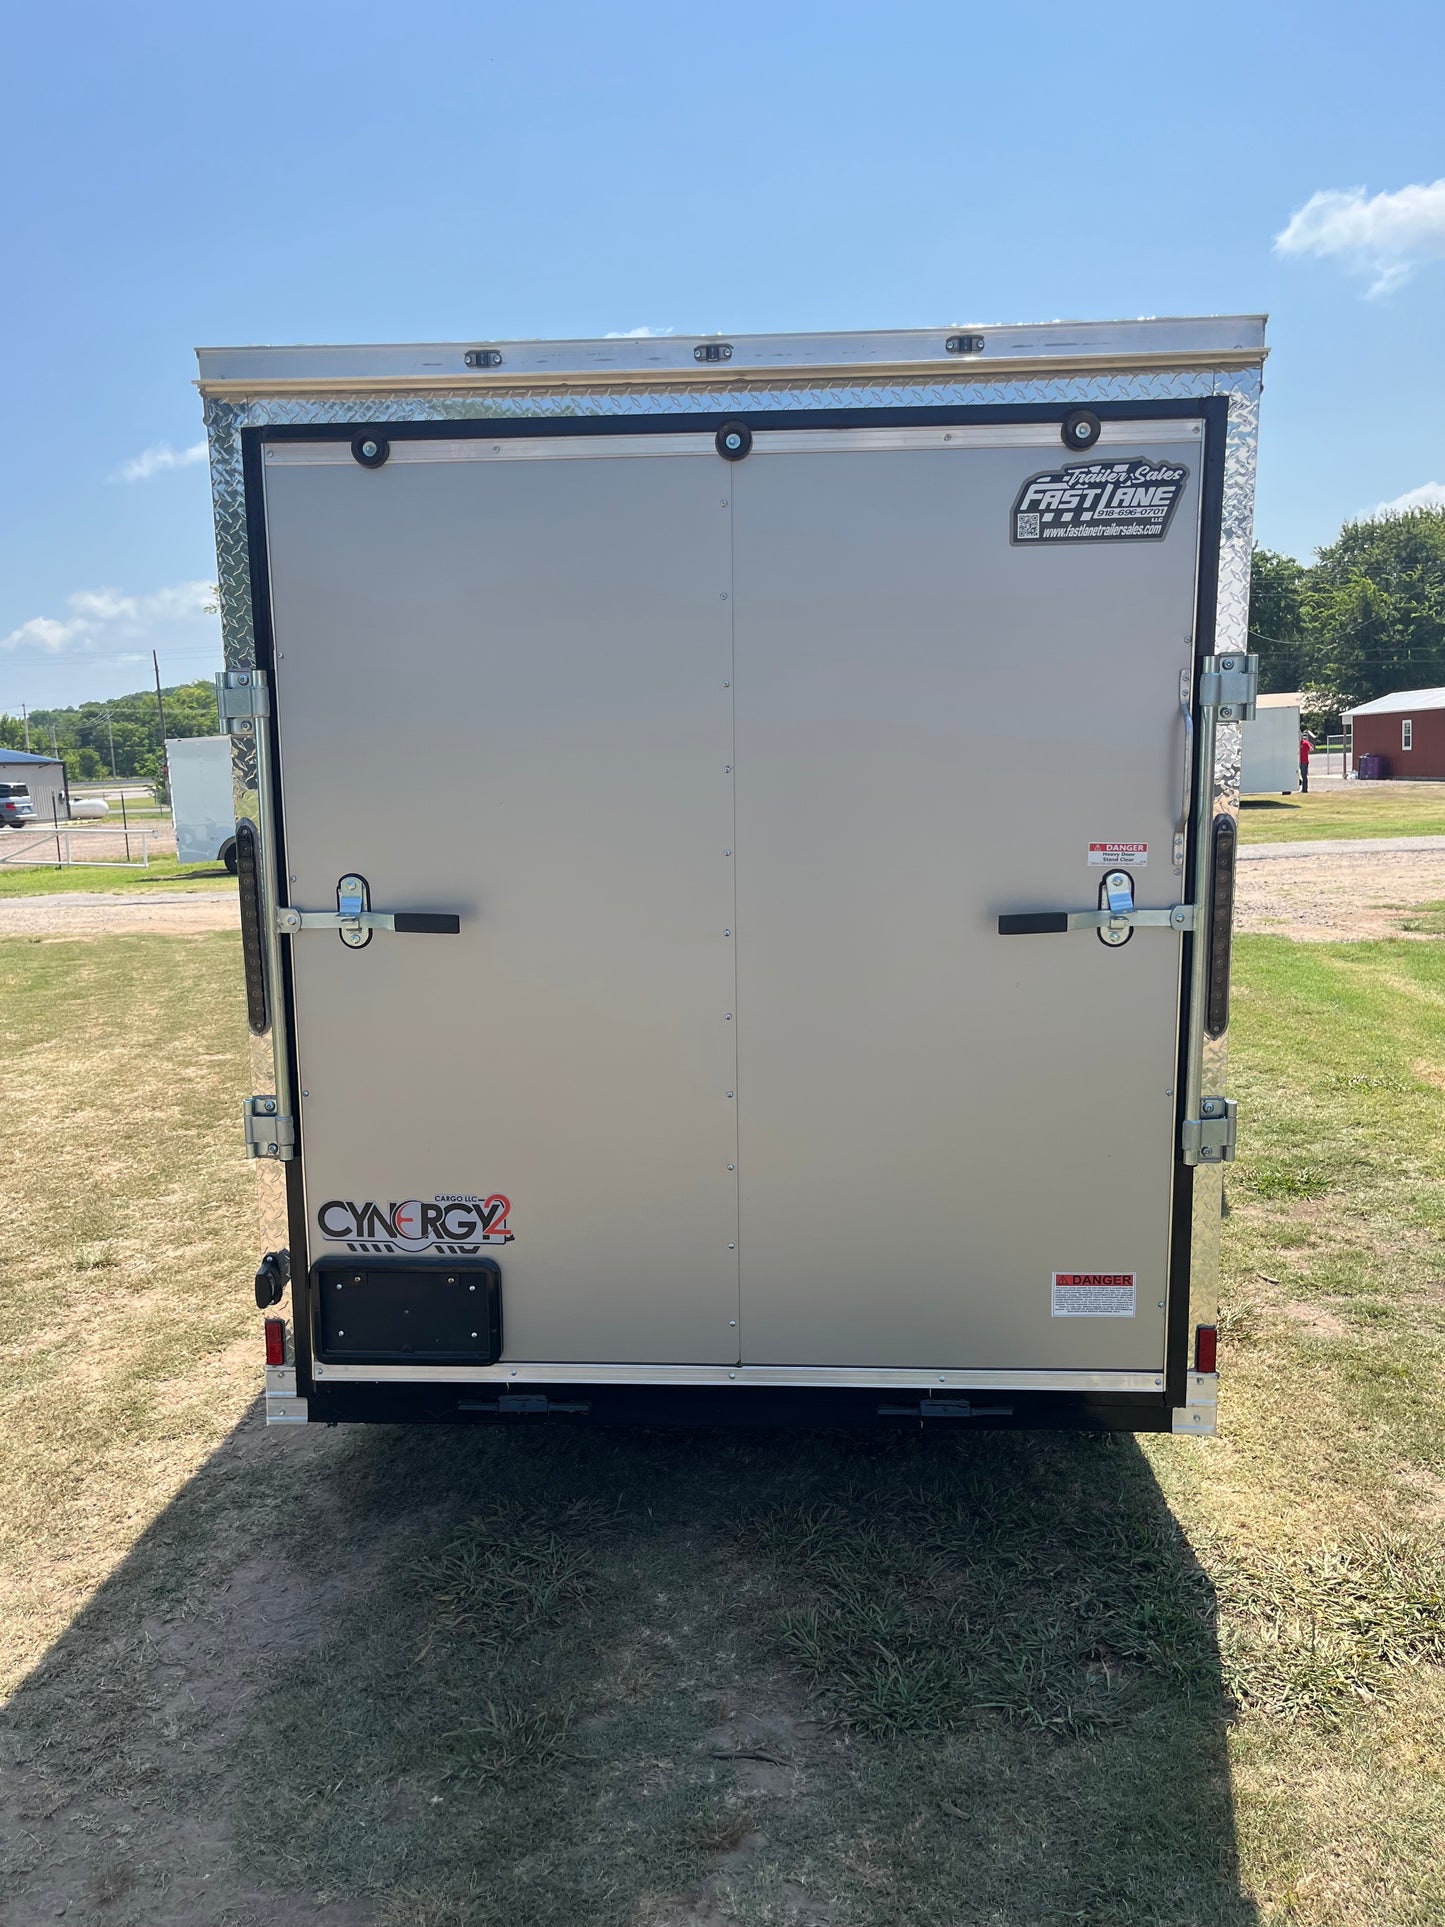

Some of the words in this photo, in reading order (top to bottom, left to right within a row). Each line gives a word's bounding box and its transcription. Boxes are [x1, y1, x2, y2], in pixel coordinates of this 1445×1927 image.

[1067, 467, 1128, 485] Trailer
[1130, 465, 1183, 483] Sales
[1097, 508, 1165, 517] 918-696-0701
[1042, 522, 1162, 538] www.fastlanetrailersales.com
[434, 1195, 463, 1203] CARGO
[1072, 1275, 1131, 1285] DANGER
